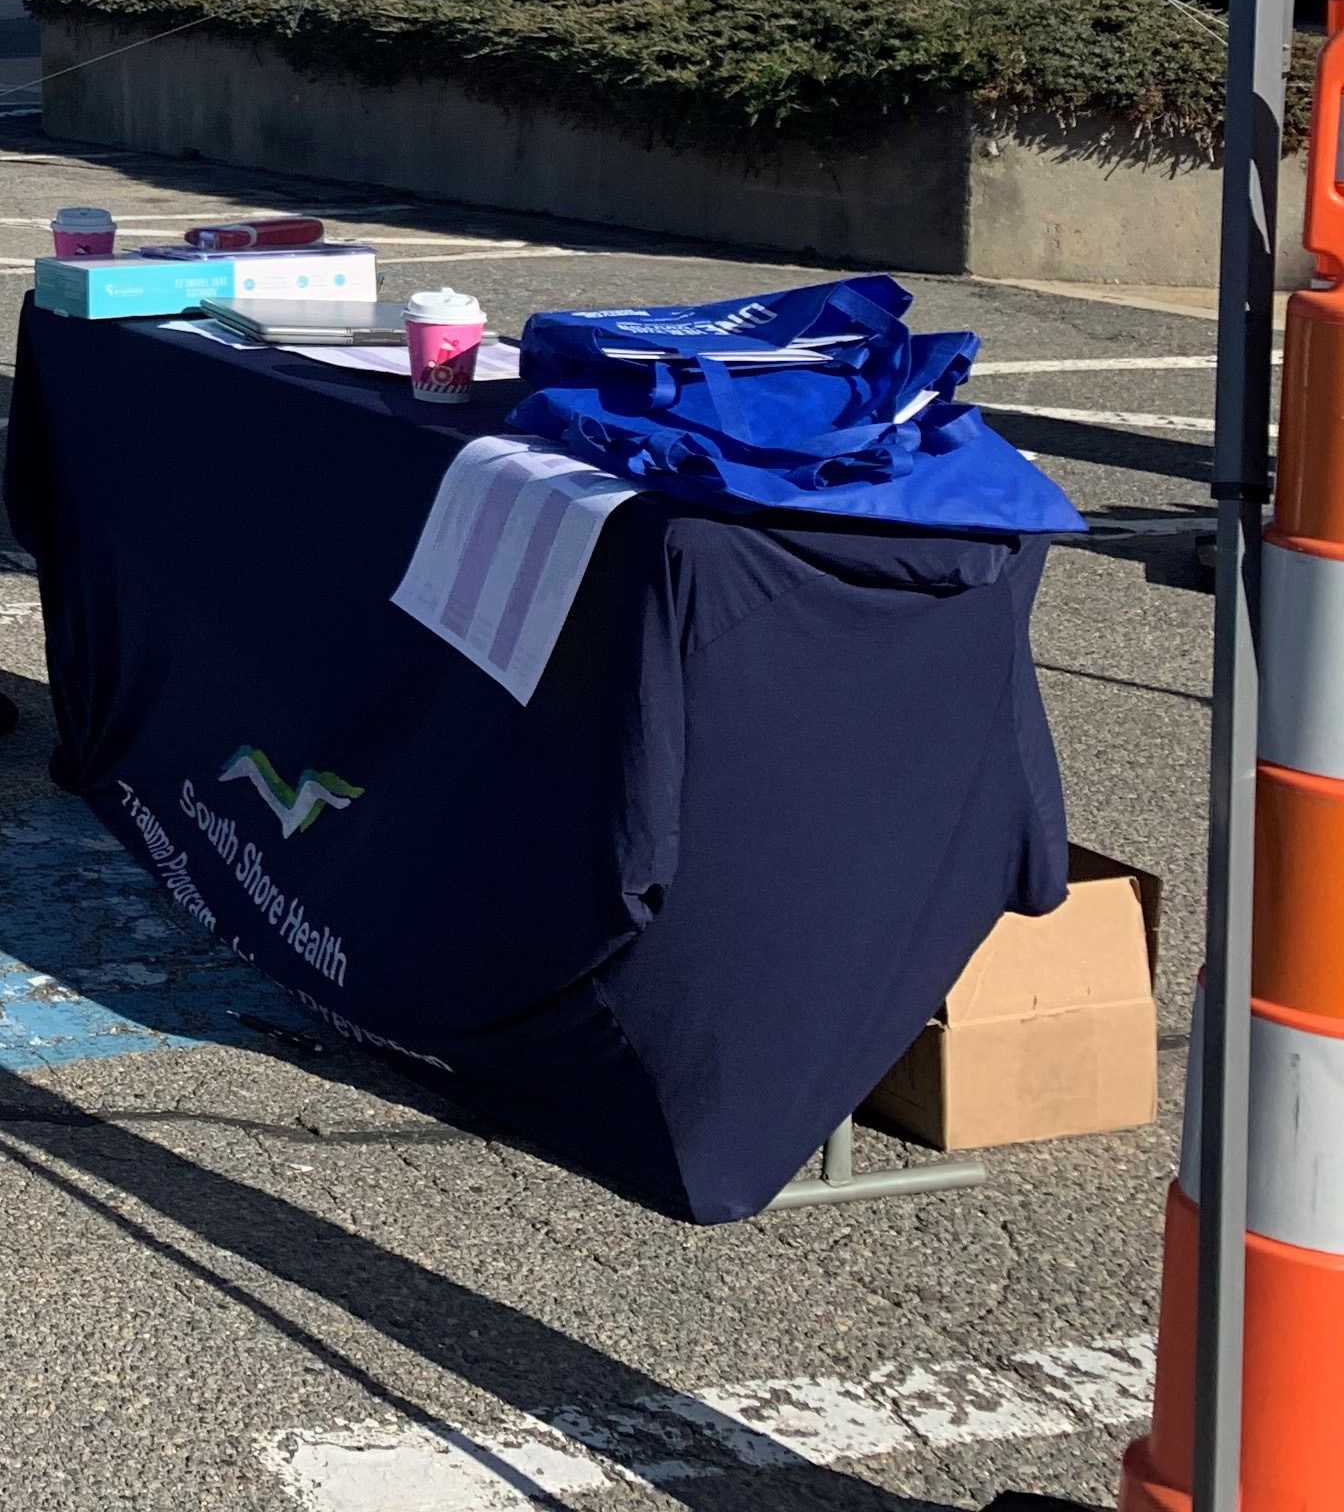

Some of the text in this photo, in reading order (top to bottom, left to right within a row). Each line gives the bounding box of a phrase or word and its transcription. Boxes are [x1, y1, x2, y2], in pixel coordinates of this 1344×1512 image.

[117, 780, 217, 933] Trauma Program
[180, 779, 238, 865] South
[236, 842, 285, 926] Shore
[279, 898, 347, 988] Health
